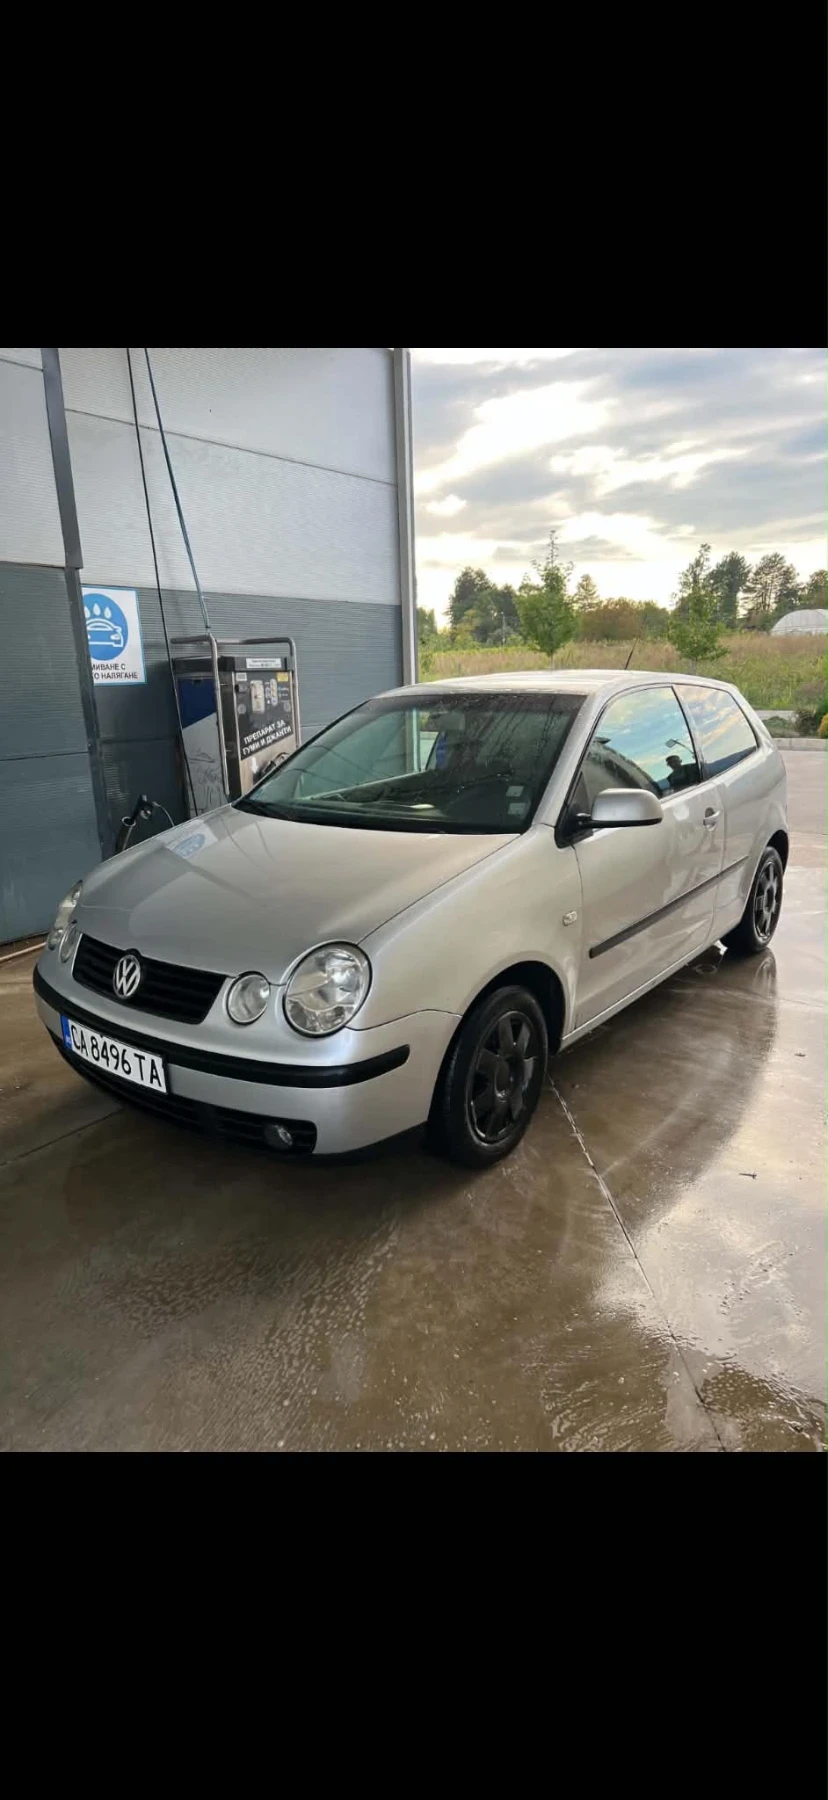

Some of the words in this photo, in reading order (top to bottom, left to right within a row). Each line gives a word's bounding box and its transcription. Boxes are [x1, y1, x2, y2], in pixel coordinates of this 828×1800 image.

[101, 672, 138, 680] НАЛЯГАНЕ
[242, 741, 260, 755] ГУМИ
[260, 738, 266, 746] И
[266, 725, 292, 745] ДЖАНТИ
[244, 723, 276, 745] ПРЕПАРАТ
[276, 719, 286, 729] ЗА
[71, 1024, 89, 1057] CA
[90, 1035, 132, 1076] 8496
[133, 1052, 162, 1088] TA
